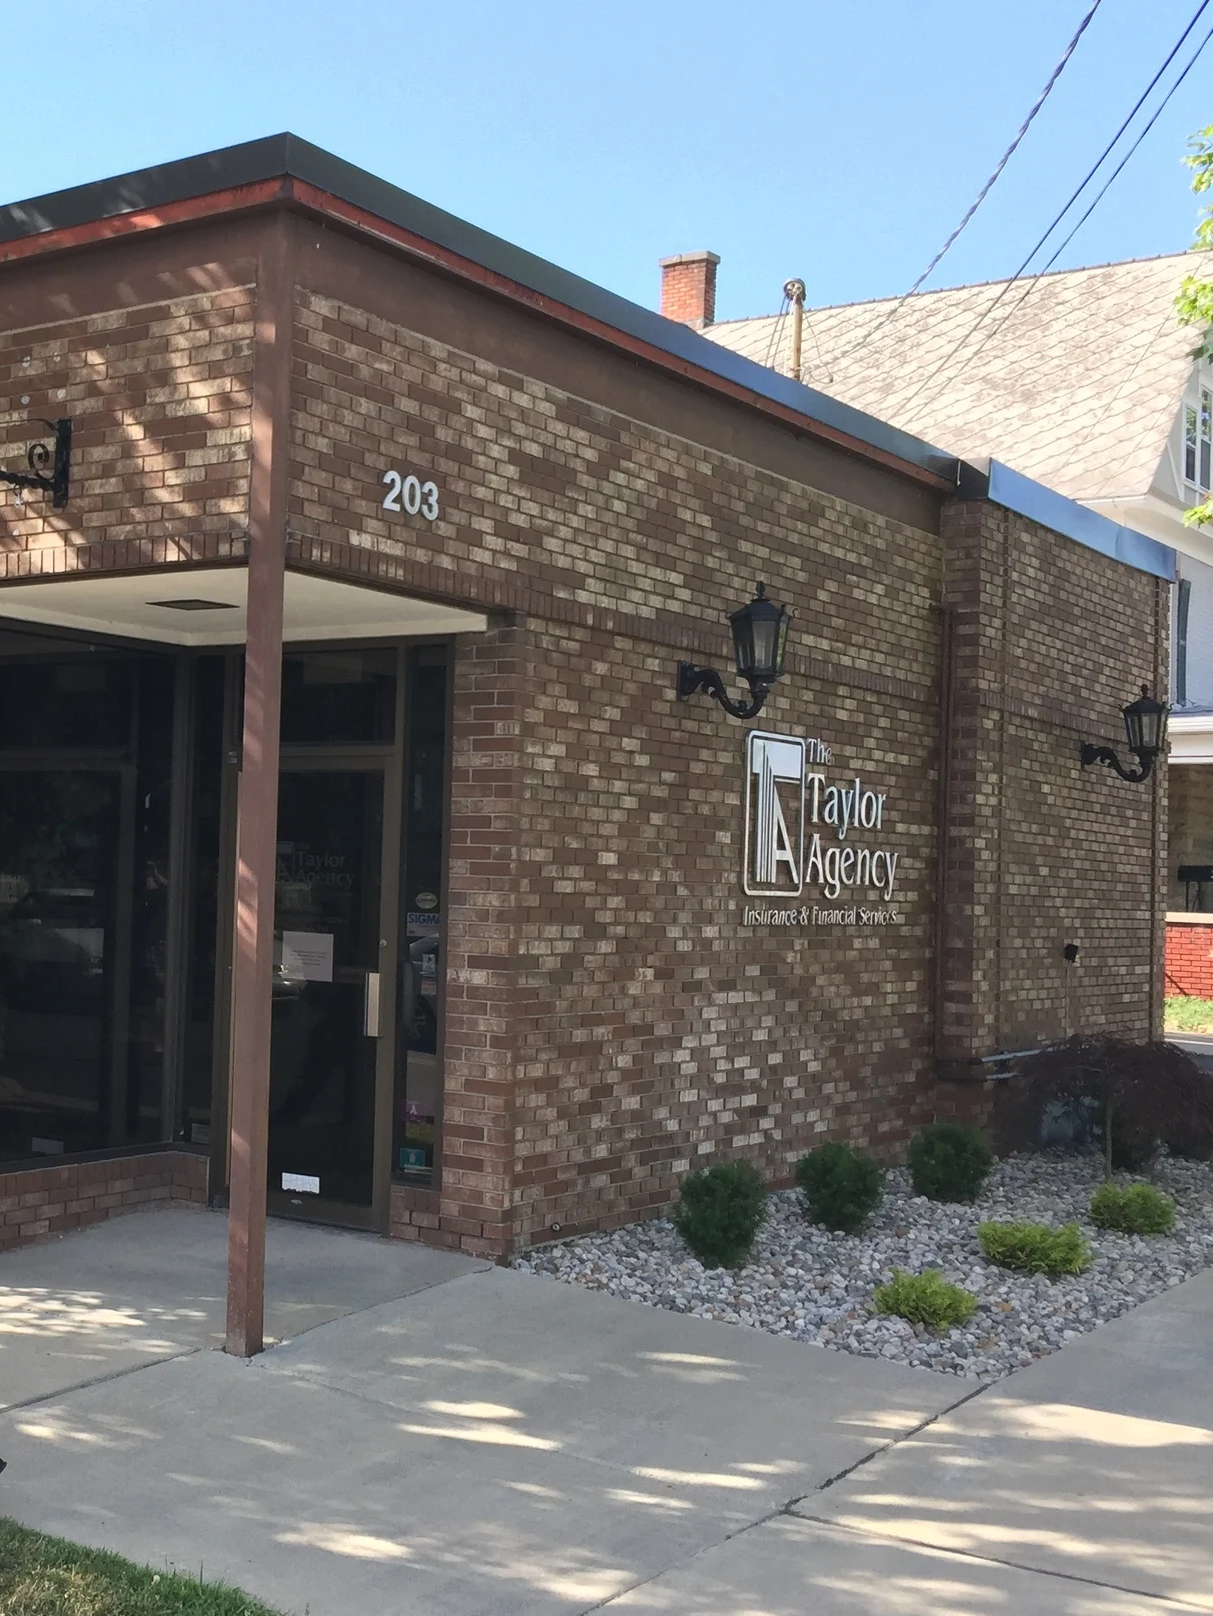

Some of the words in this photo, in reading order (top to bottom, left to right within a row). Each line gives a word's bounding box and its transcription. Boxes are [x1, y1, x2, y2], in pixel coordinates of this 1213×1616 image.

[382, 470, 439, 520] 203
[808, 738, 832, 764] The
[807, 773, 886, 840] Taylor
[296, 851, 346, 871] Taylor
[805, 833, 899, 901] Agency
[744, 905, 797, 926] Insurance
[798, 906, 810, 925] &
[812, 906, 856, 925] Financial
